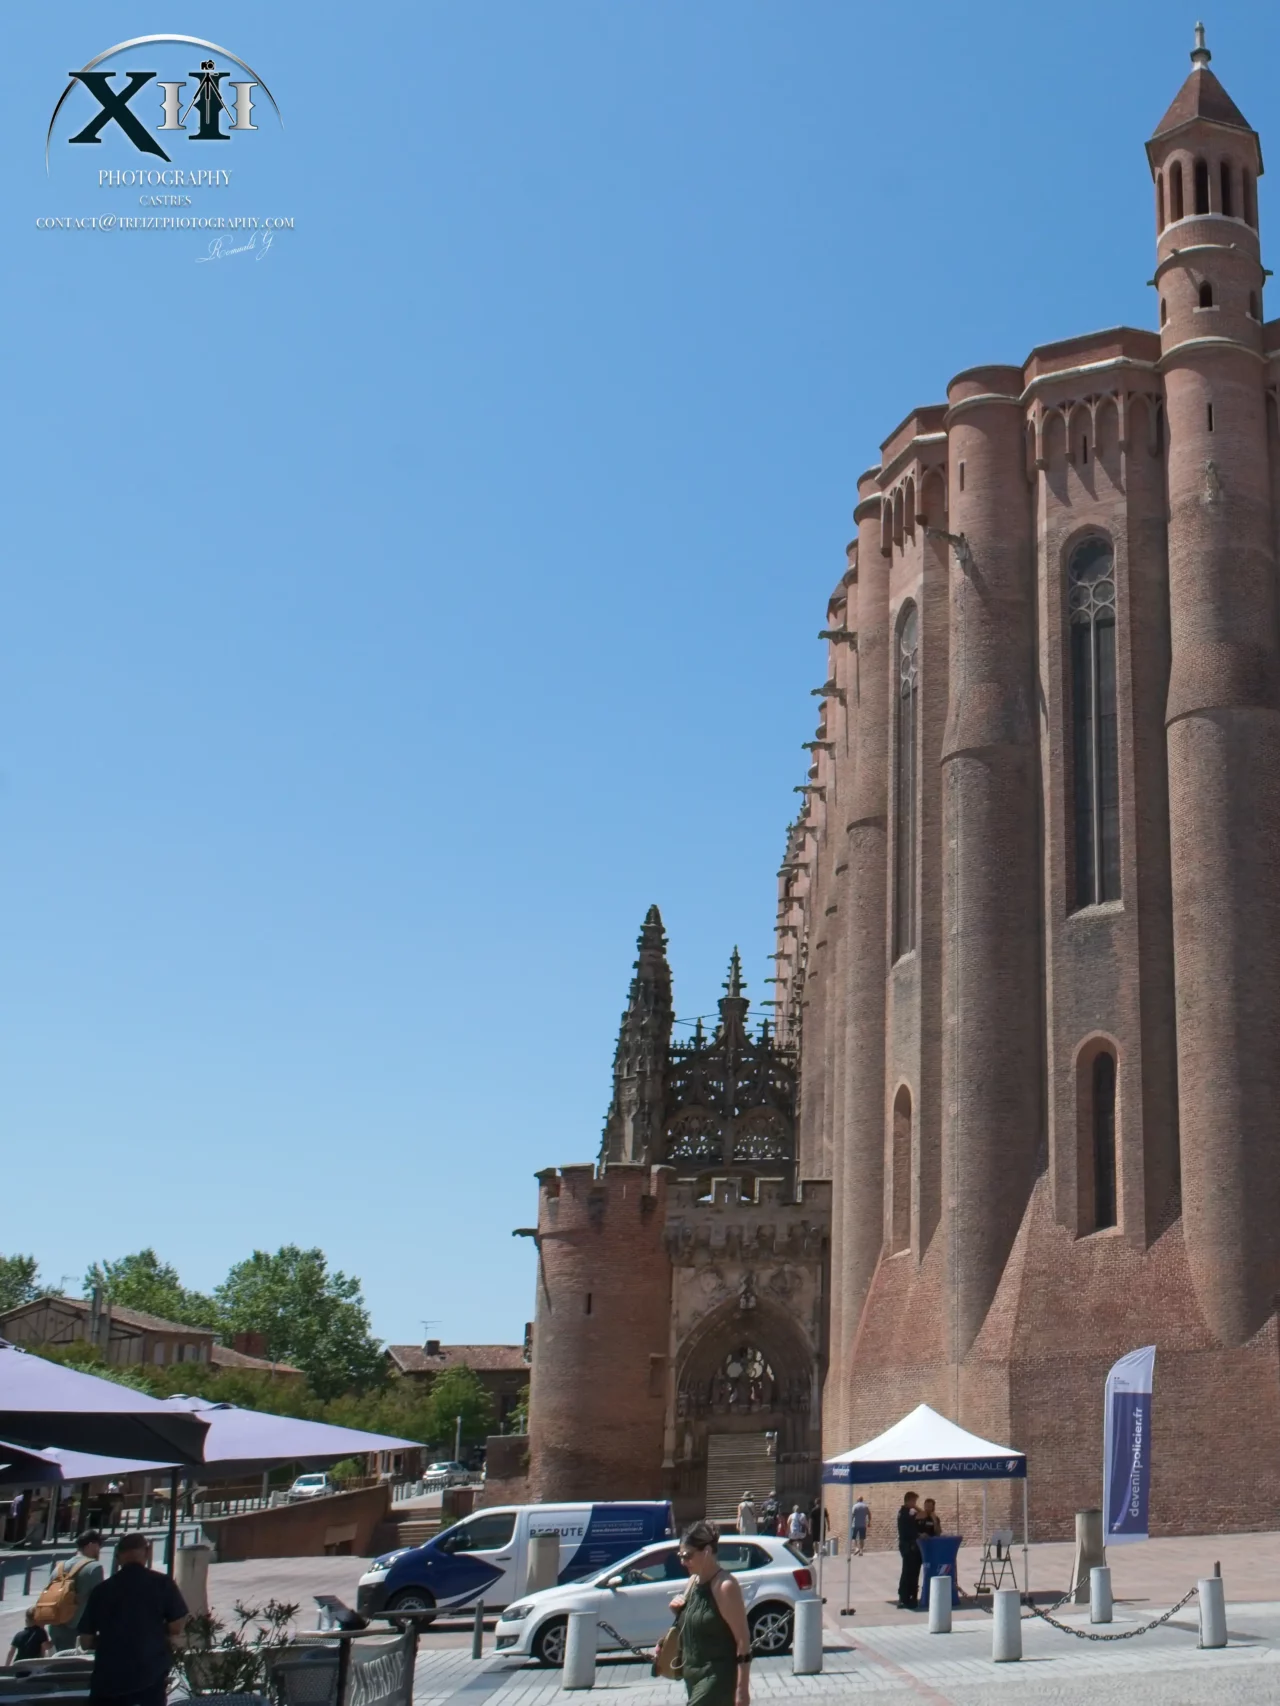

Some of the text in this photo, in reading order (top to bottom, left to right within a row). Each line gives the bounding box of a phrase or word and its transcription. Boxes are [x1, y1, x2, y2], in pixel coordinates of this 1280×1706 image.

[900, 1461, 1003, 1473] POLICE NATIONALE
[1129, 1407, 1143, 1517] devenirpolicier.fr
